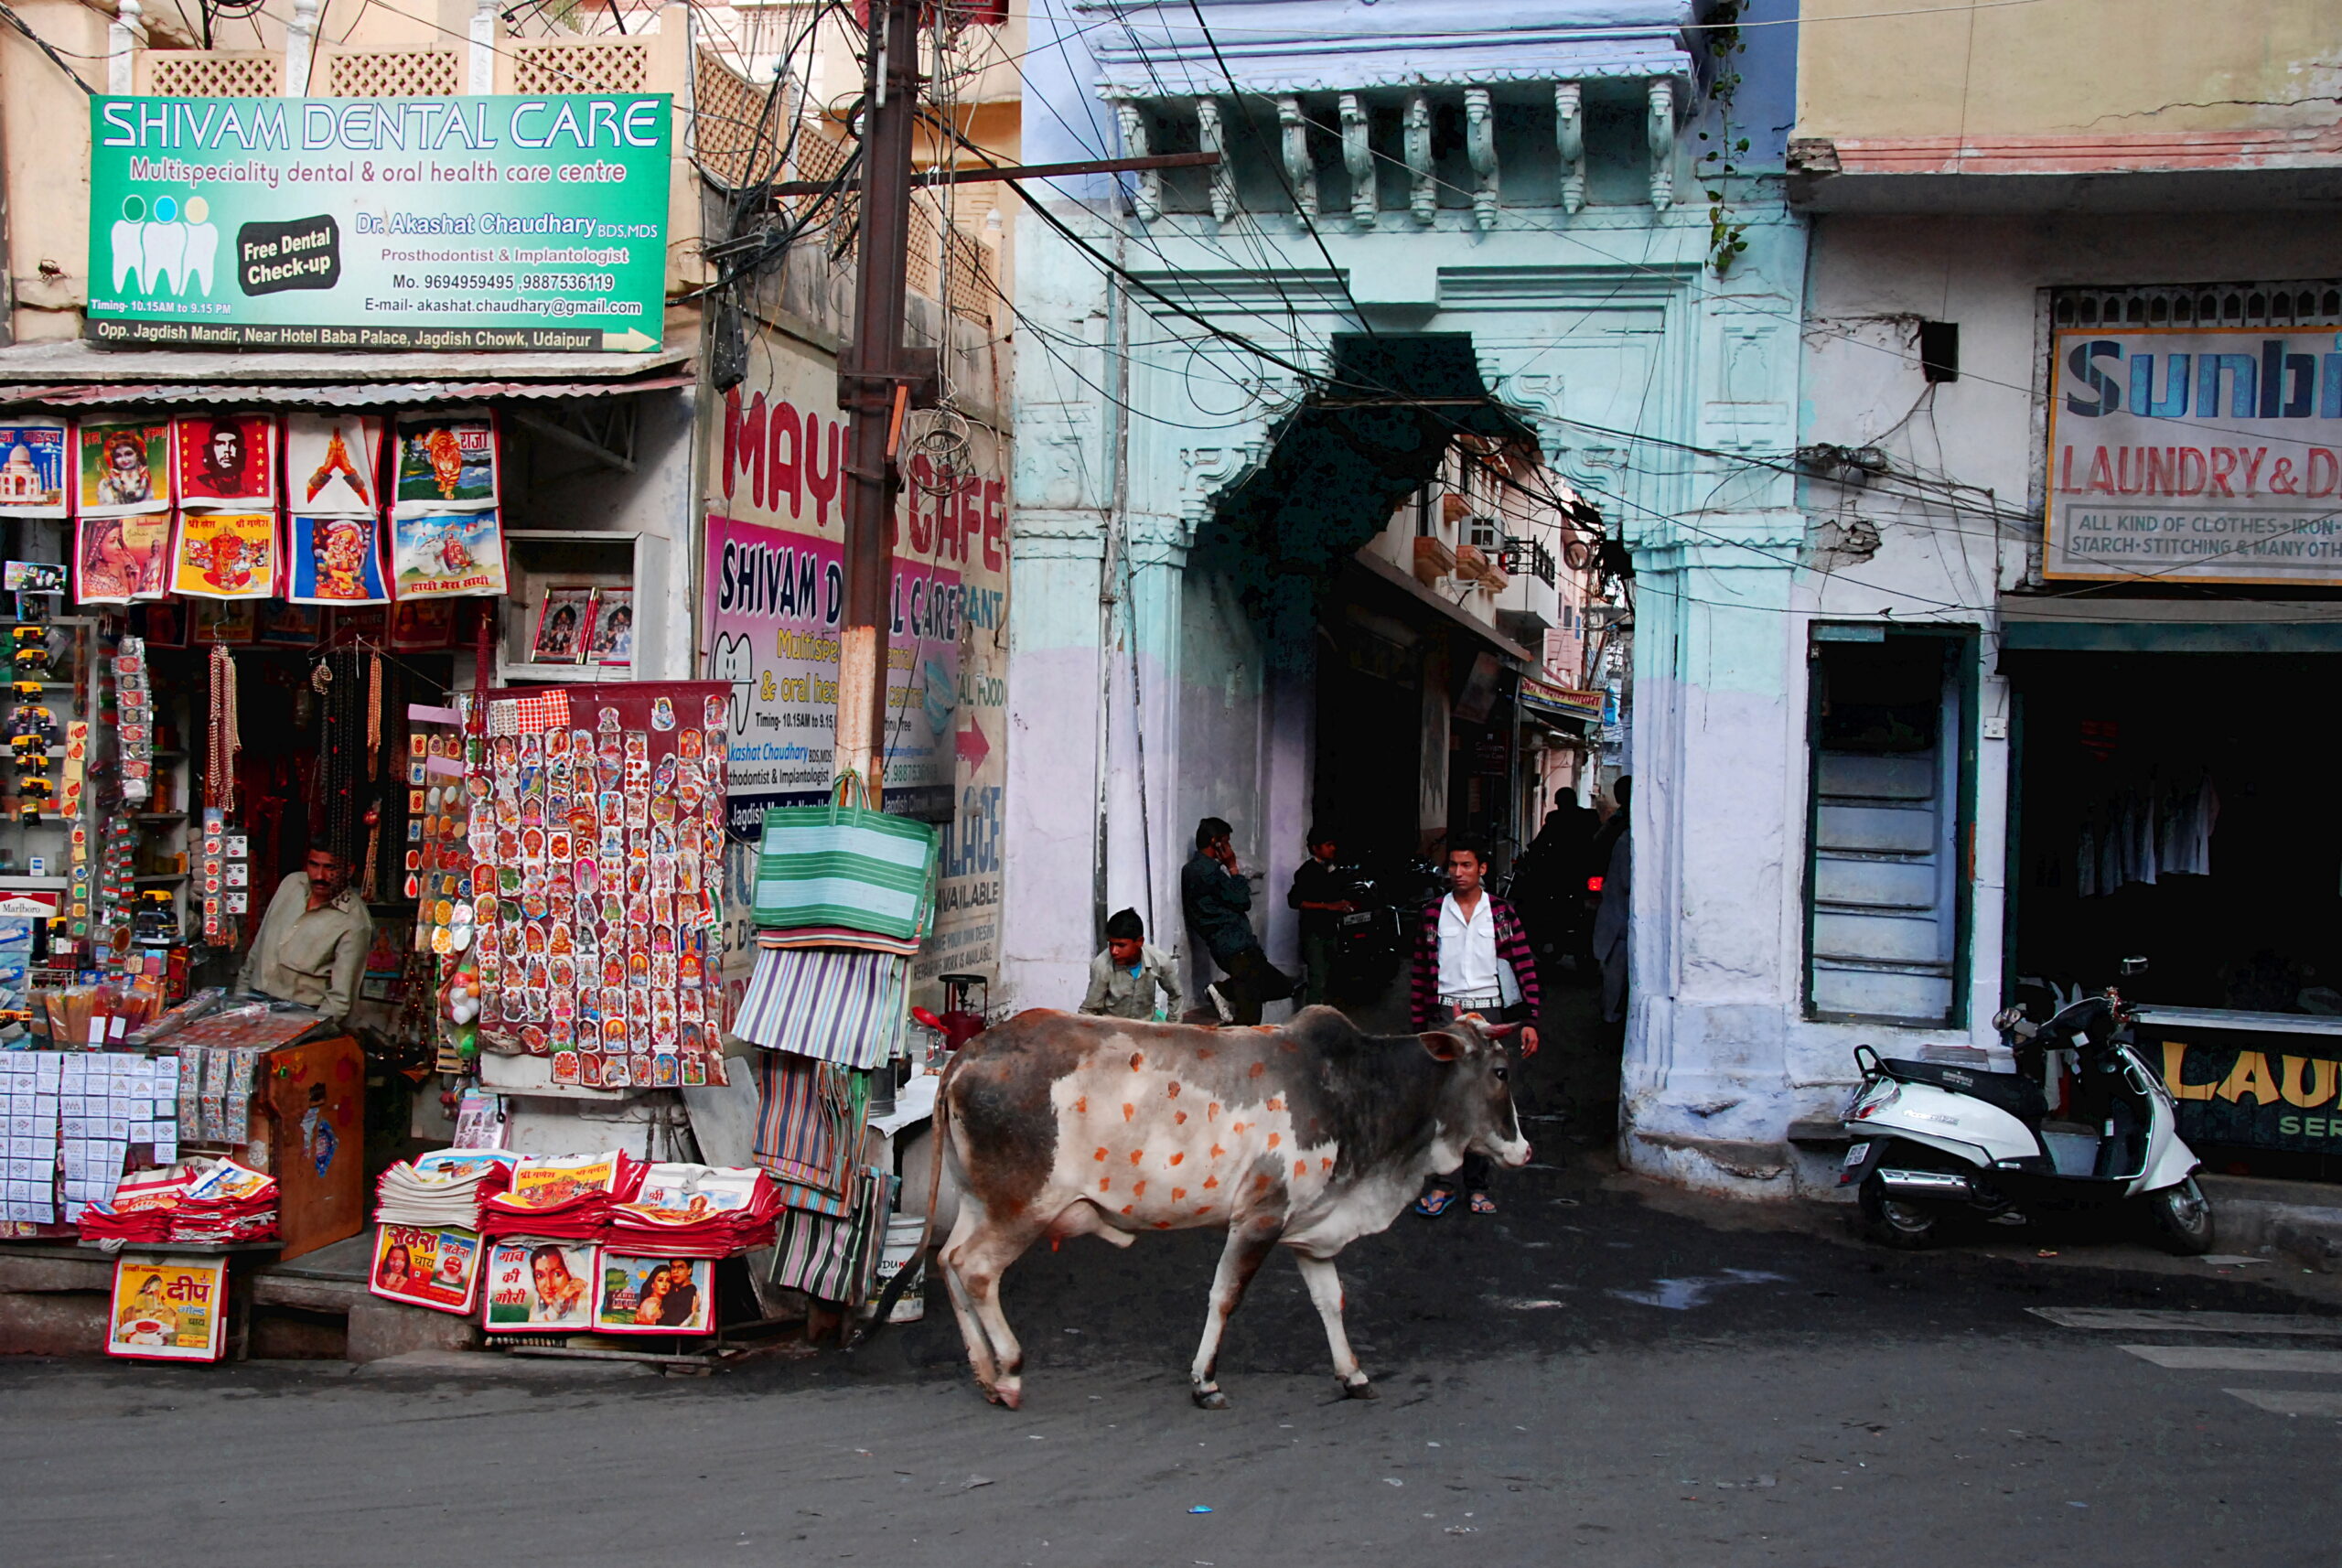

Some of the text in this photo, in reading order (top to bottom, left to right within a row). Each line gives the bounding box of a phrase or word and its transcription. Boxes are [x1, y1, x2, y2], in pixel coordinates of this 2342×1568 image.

[102, 99, 661, 151] SHIVAM DENTAL CARE
[131, 156, 627, 189] Multispeciality dental & oral health care centre
[356, 212, 658, 239] Dr. Akashat Chaudhary BDS,MDS
[243, 227, 331, 262] Free Dental
[381, 248, 629, 265] Prosthodontist & Implantologist
[247, 254, 331, 285] Check-up
[392, 274, 419, 289] Mo.
[424, 275, 514, 290] 9694959495
[91, 299, 231, 316] Timing- 10.15AM to 9.15 PM
[365, 297, 642, 317] E-mail- akashat.chaudhary@gmail.com
[98, 322, 592, 351] Opp. Jagdish Mandir, Near Hotel Baba Palace, Jagdish Chowk, Udaipur
[459, 431, 489, 449] राजा
[2060, 445, 2268, 499] LAUNDRY
[2269, 456, 2299, 496] &
[908, 453, 1006, 573] CAFE
[2079, 515, 2111, 532] ALL
[2118, 516, 2158, 532] KIND
[2164, 517, 2186, 532] OF
[2192, 517, 2278, 534] CLOTHES
[2253, 539, 2305, 557] MANY
[719, 538, 819, 623] SHIVAM
[910, 576, 960, 643] CARE
[760, 671, 777, 702] &
[781, 672, 811, 703] oral
[783, 713, 811, 728] 10.15AM
[811, 714, 819, 728] to
[763, 742, 809, 765] Chaudhary
[771, 768, 779, 785] &
[779, 768, 830, 788] Implantologist
[3, 903, 40, 913] Marlboro
[414, 1254, 435, 1269] चाय
[502, 1268, 521, 1283] की
[167, 1274, 211, 1304] दीप
[495, 1288, 526, 1305] गौरी
